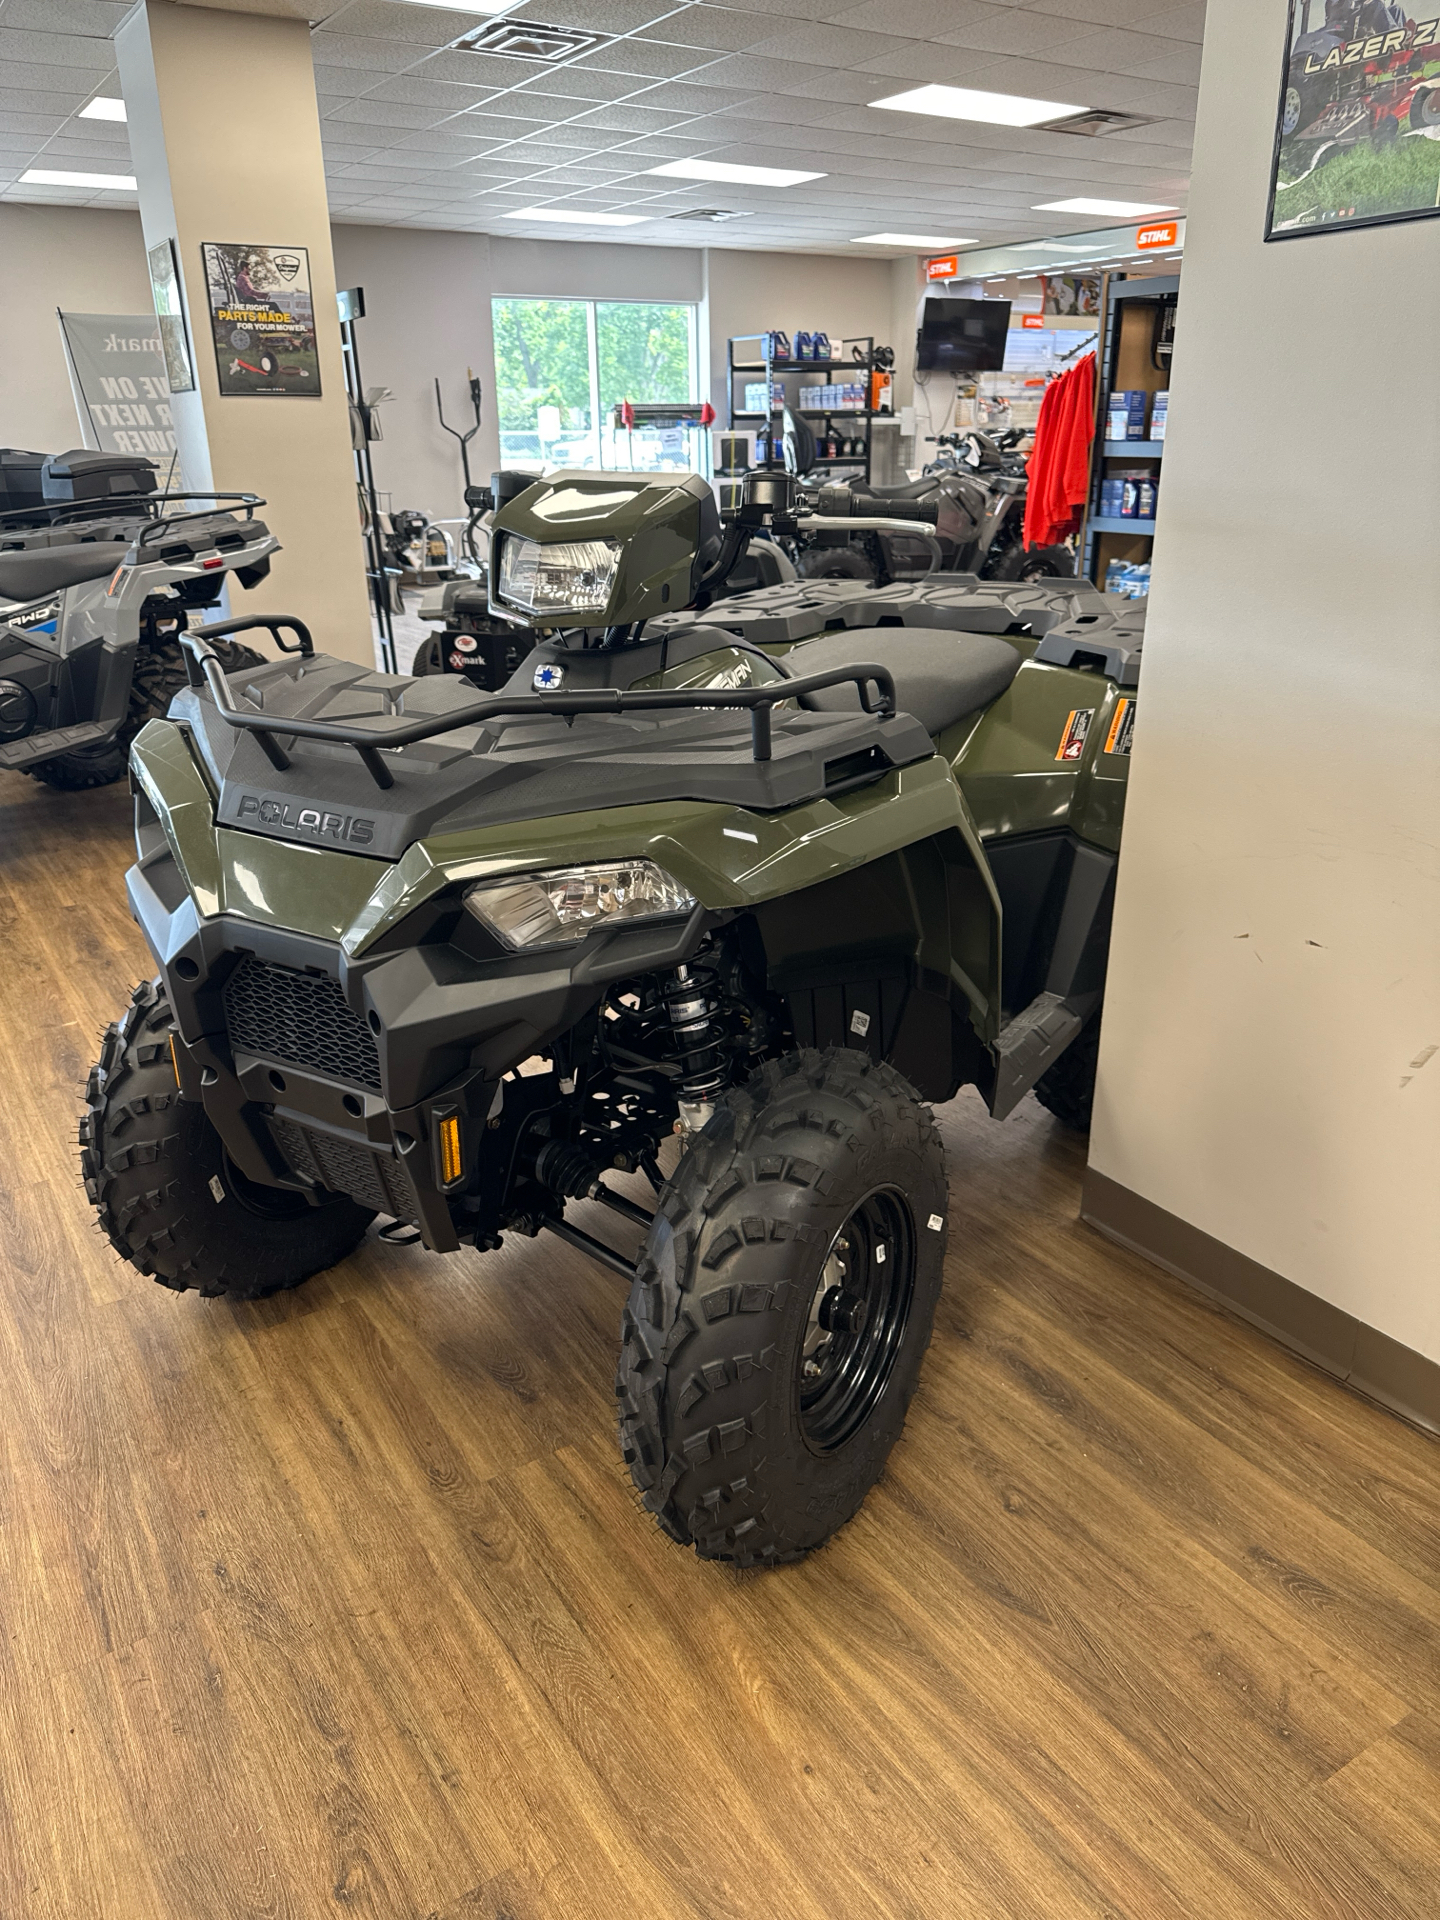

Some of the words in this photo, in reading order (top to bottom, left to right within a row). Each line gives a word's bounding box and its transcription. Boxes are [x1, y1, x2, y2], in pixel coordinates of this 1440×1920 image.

[1303, 28, 1407, 76] LAZER
[1138, 229, 1171, 244] STIHL
[929, 262, 953, 275] STIHL
[229, 303, 246, 311] THE
[218, 310, 256, 321] PARTS
[257, 312, 291, 323] MADE
[254, 323, 276, 331] YOUR
[276, 324, 308, 332] MOWER.
[8, 608, 50, 628] AWD
[237, 795, 376, 845] POLARIS
